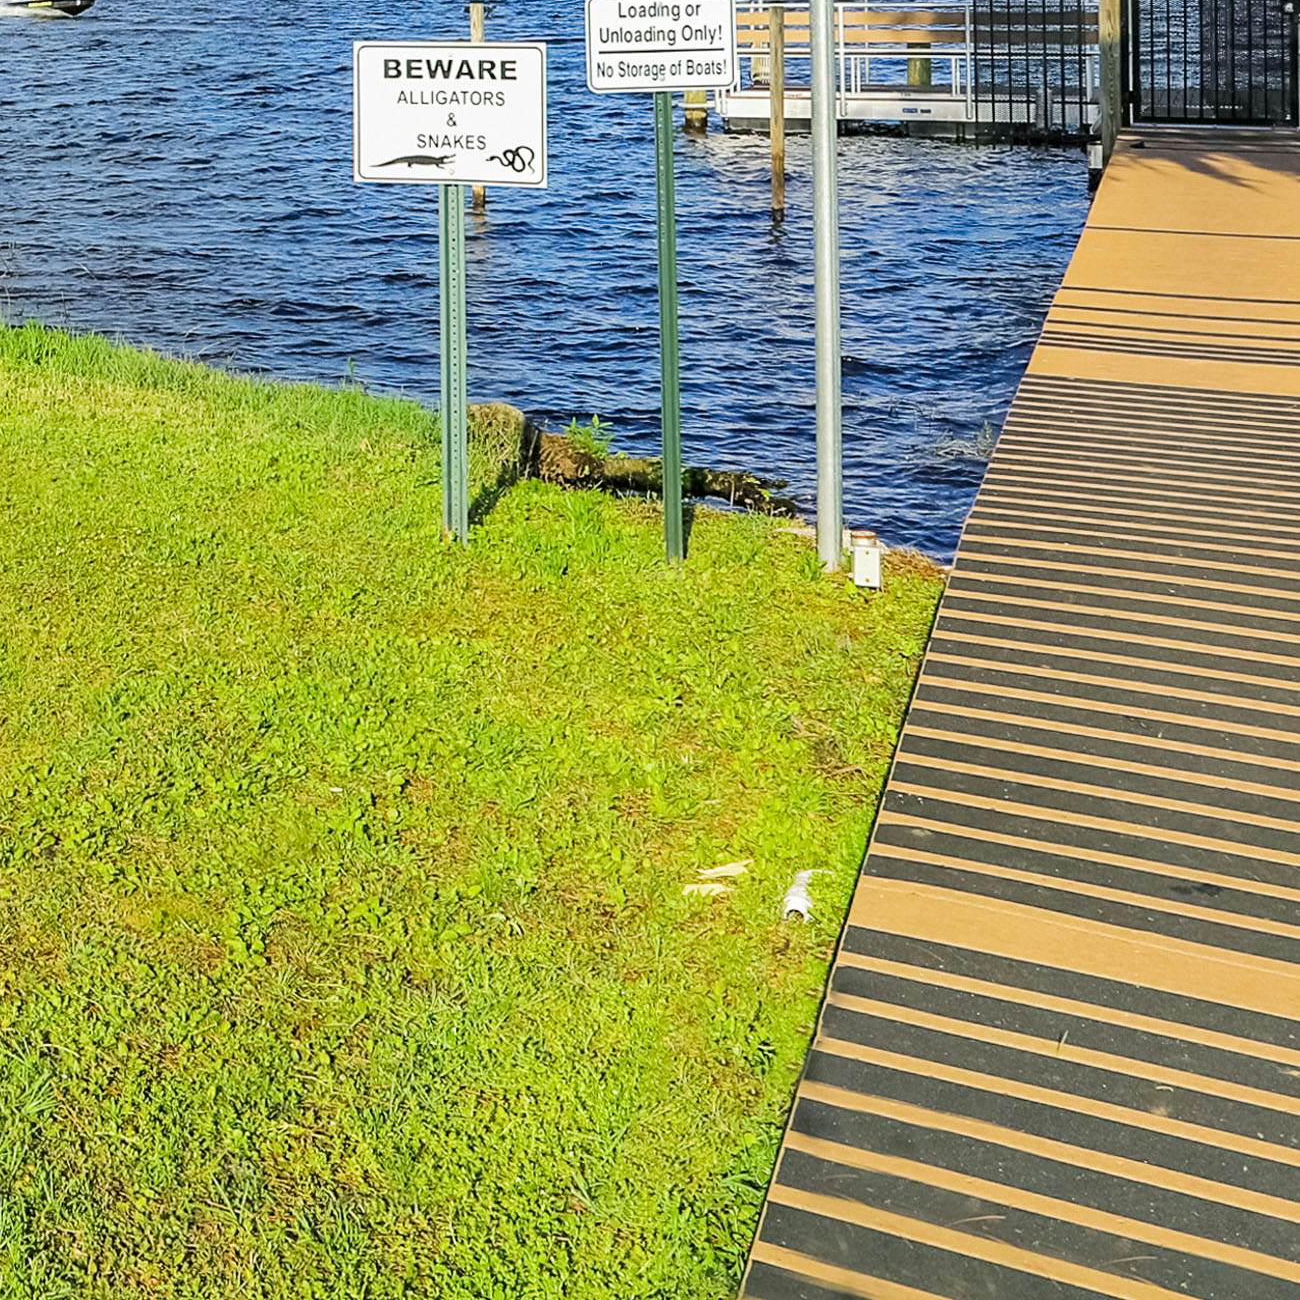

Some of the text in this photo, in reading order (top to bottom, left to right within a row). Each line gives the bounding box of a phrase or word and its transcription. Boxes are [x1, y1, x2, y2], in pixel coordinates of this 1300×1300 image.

[618, 2, 701, 21] Loading or
[599, 25, 722, 46] Unloading Only!
[383, 58, 517, 80] BEWARE
[596, 59, 727, 81] No Storage of Boats!
[397, 90, 505, 106] ALLIGATORS
[446, 112, 457, 127] &
[416, 133, 486, 150] SNAKES
